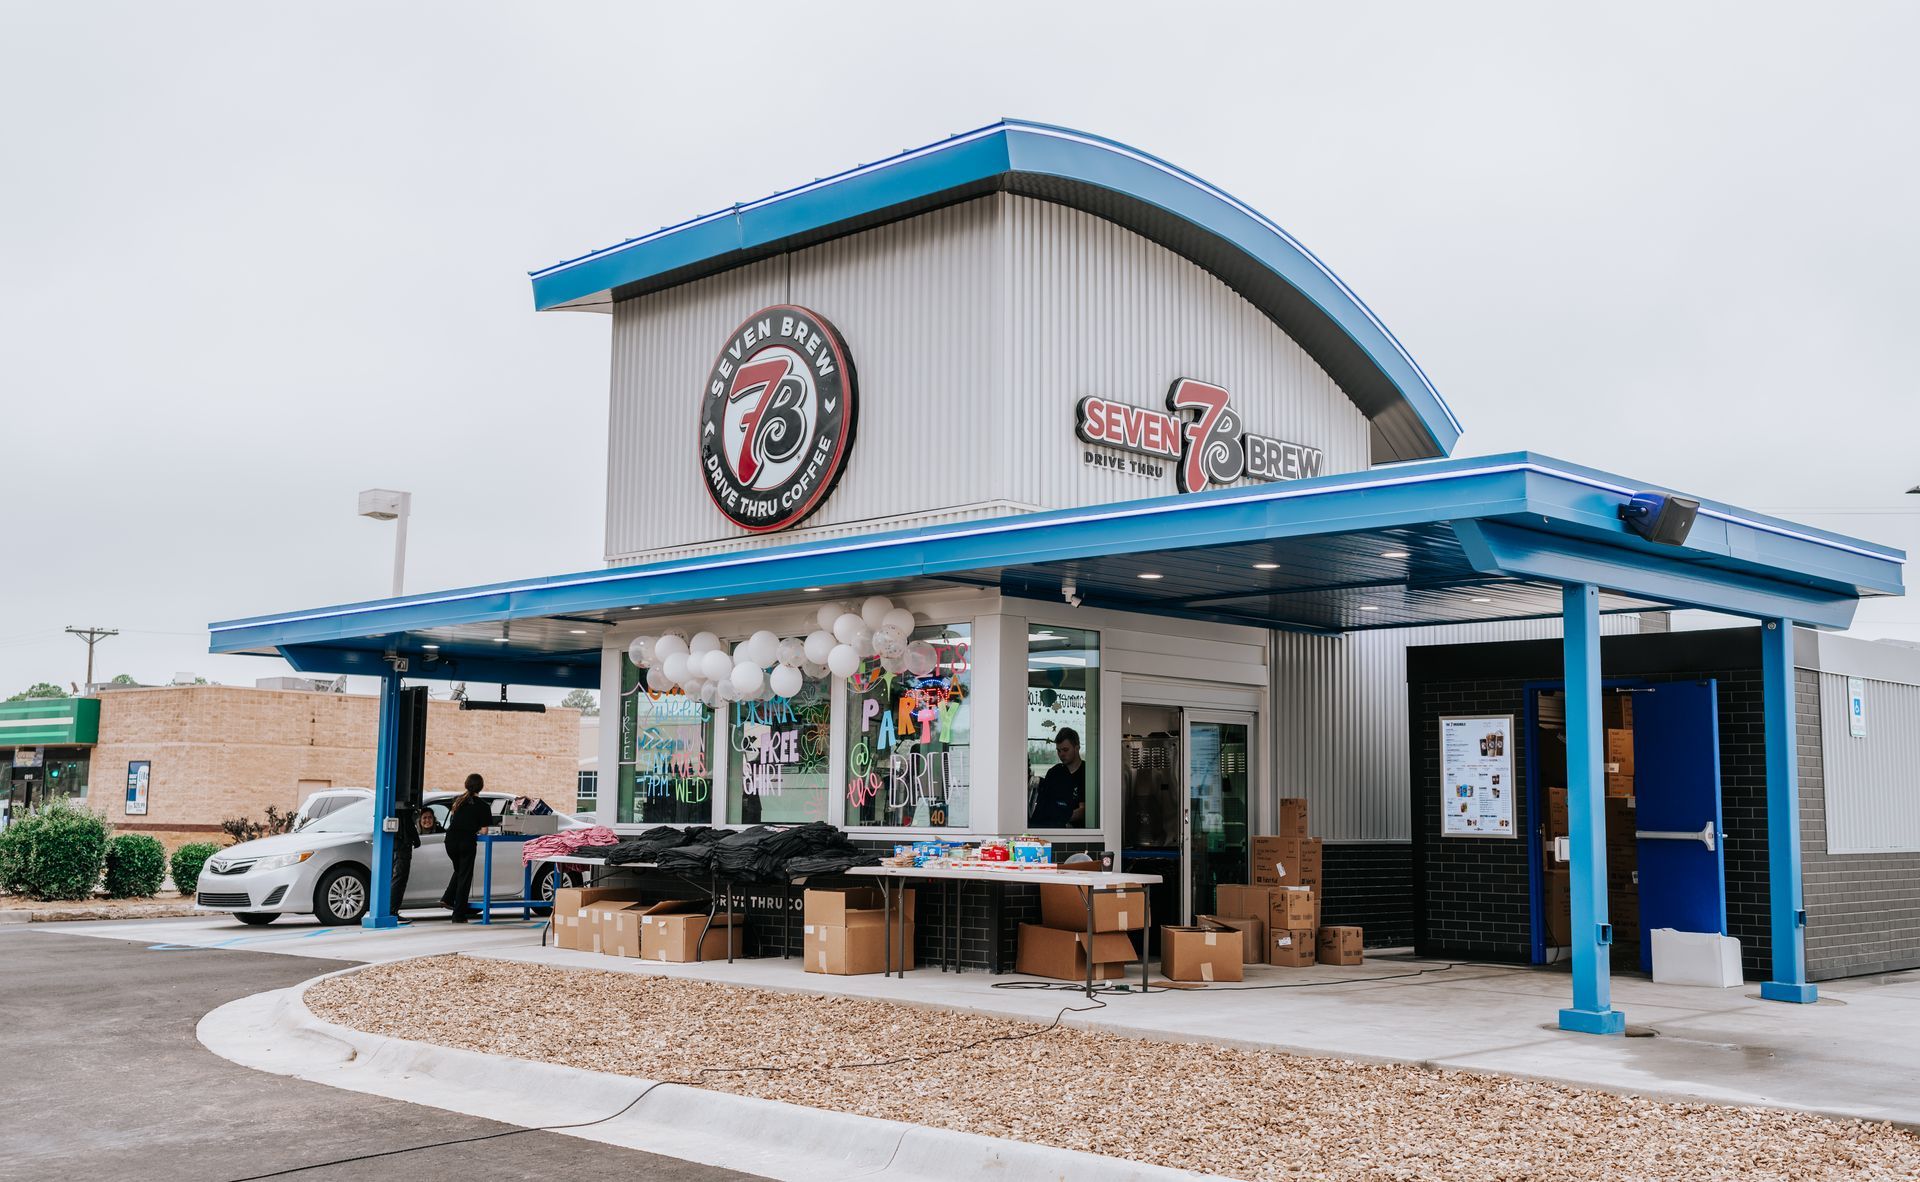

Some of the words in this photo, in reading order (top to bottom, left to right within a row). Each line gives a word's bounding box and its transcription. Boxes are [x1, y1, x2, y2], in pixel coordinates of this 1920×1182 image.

[711, 318, 771, 398] SEVEN
[781, 316, 835, 377] BREW
[1084, 397, 1181, 456] SEVEN
[1248, 435, 1322, 481] BREW
[707, 454, 736, 508] DRIVE
[740, 499, 778, 517] THRU
[782, 435, 831, 509] COFFEE
[1085, 451, 1126, 471] DRIVE
[1129, 461, 1163, 479] THRU
[862, 698, 960, 750] PARTY
[760, 730, 800, 764] FREE
[850, 742, 873, 778] @
[675, 776, 709, 804] WED
[742, 762, 784, 797] SHIRT
[847, 772, 883, 808] the
[931, 809, 945, 825] 40
[750, 896, 783, 910] THRU
